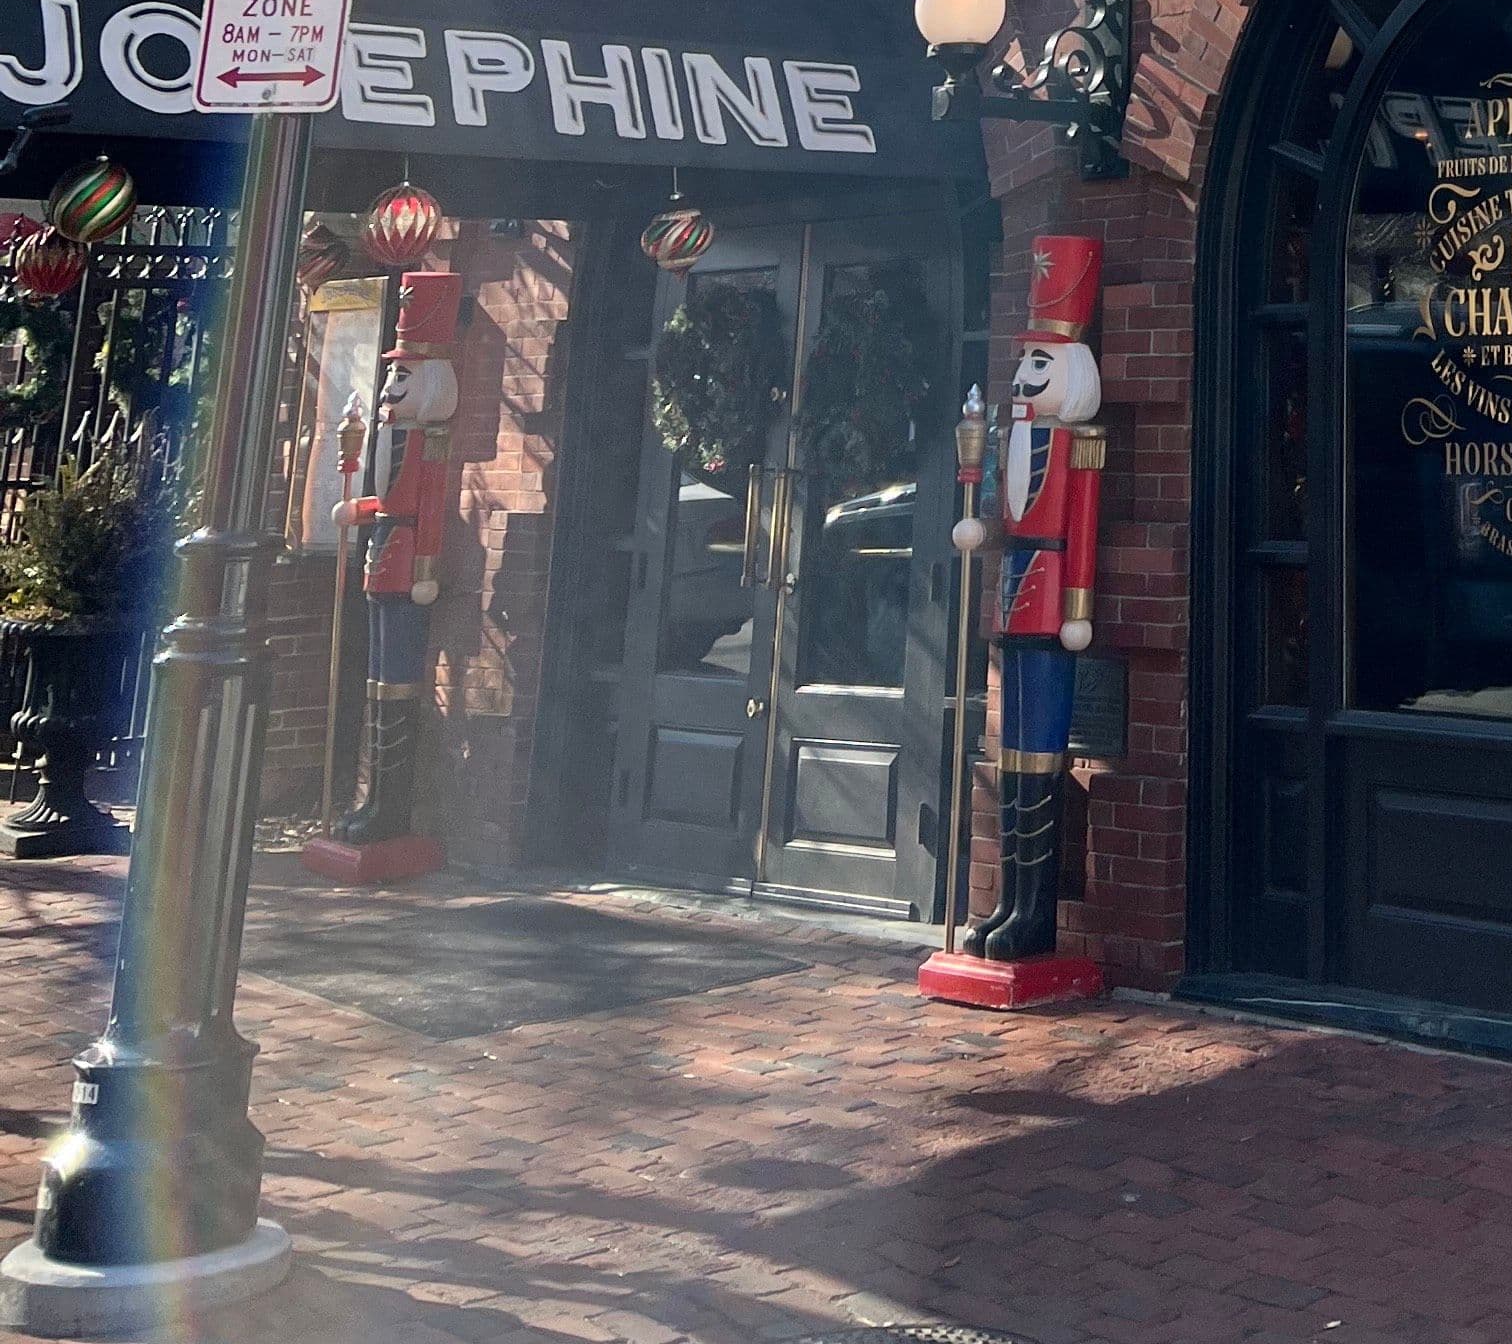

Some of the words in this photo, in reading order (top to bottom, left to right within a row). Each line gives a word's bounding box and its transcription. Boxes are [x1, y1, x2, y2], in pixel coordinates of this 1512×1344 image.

[222, 23, 260, 44] 8AM
[290, 25, 324, 43] 7PM
[1437, 156, 1486, 179] FRUITS
[1489, 155, 1508, 175] DE
[1429, 194, 1503, 273] CUISINE
[1481, 344, 1501, 367] ET
[1431, 347, 1466, 396] LES
[1466, 380, 1511, 424] VINS
